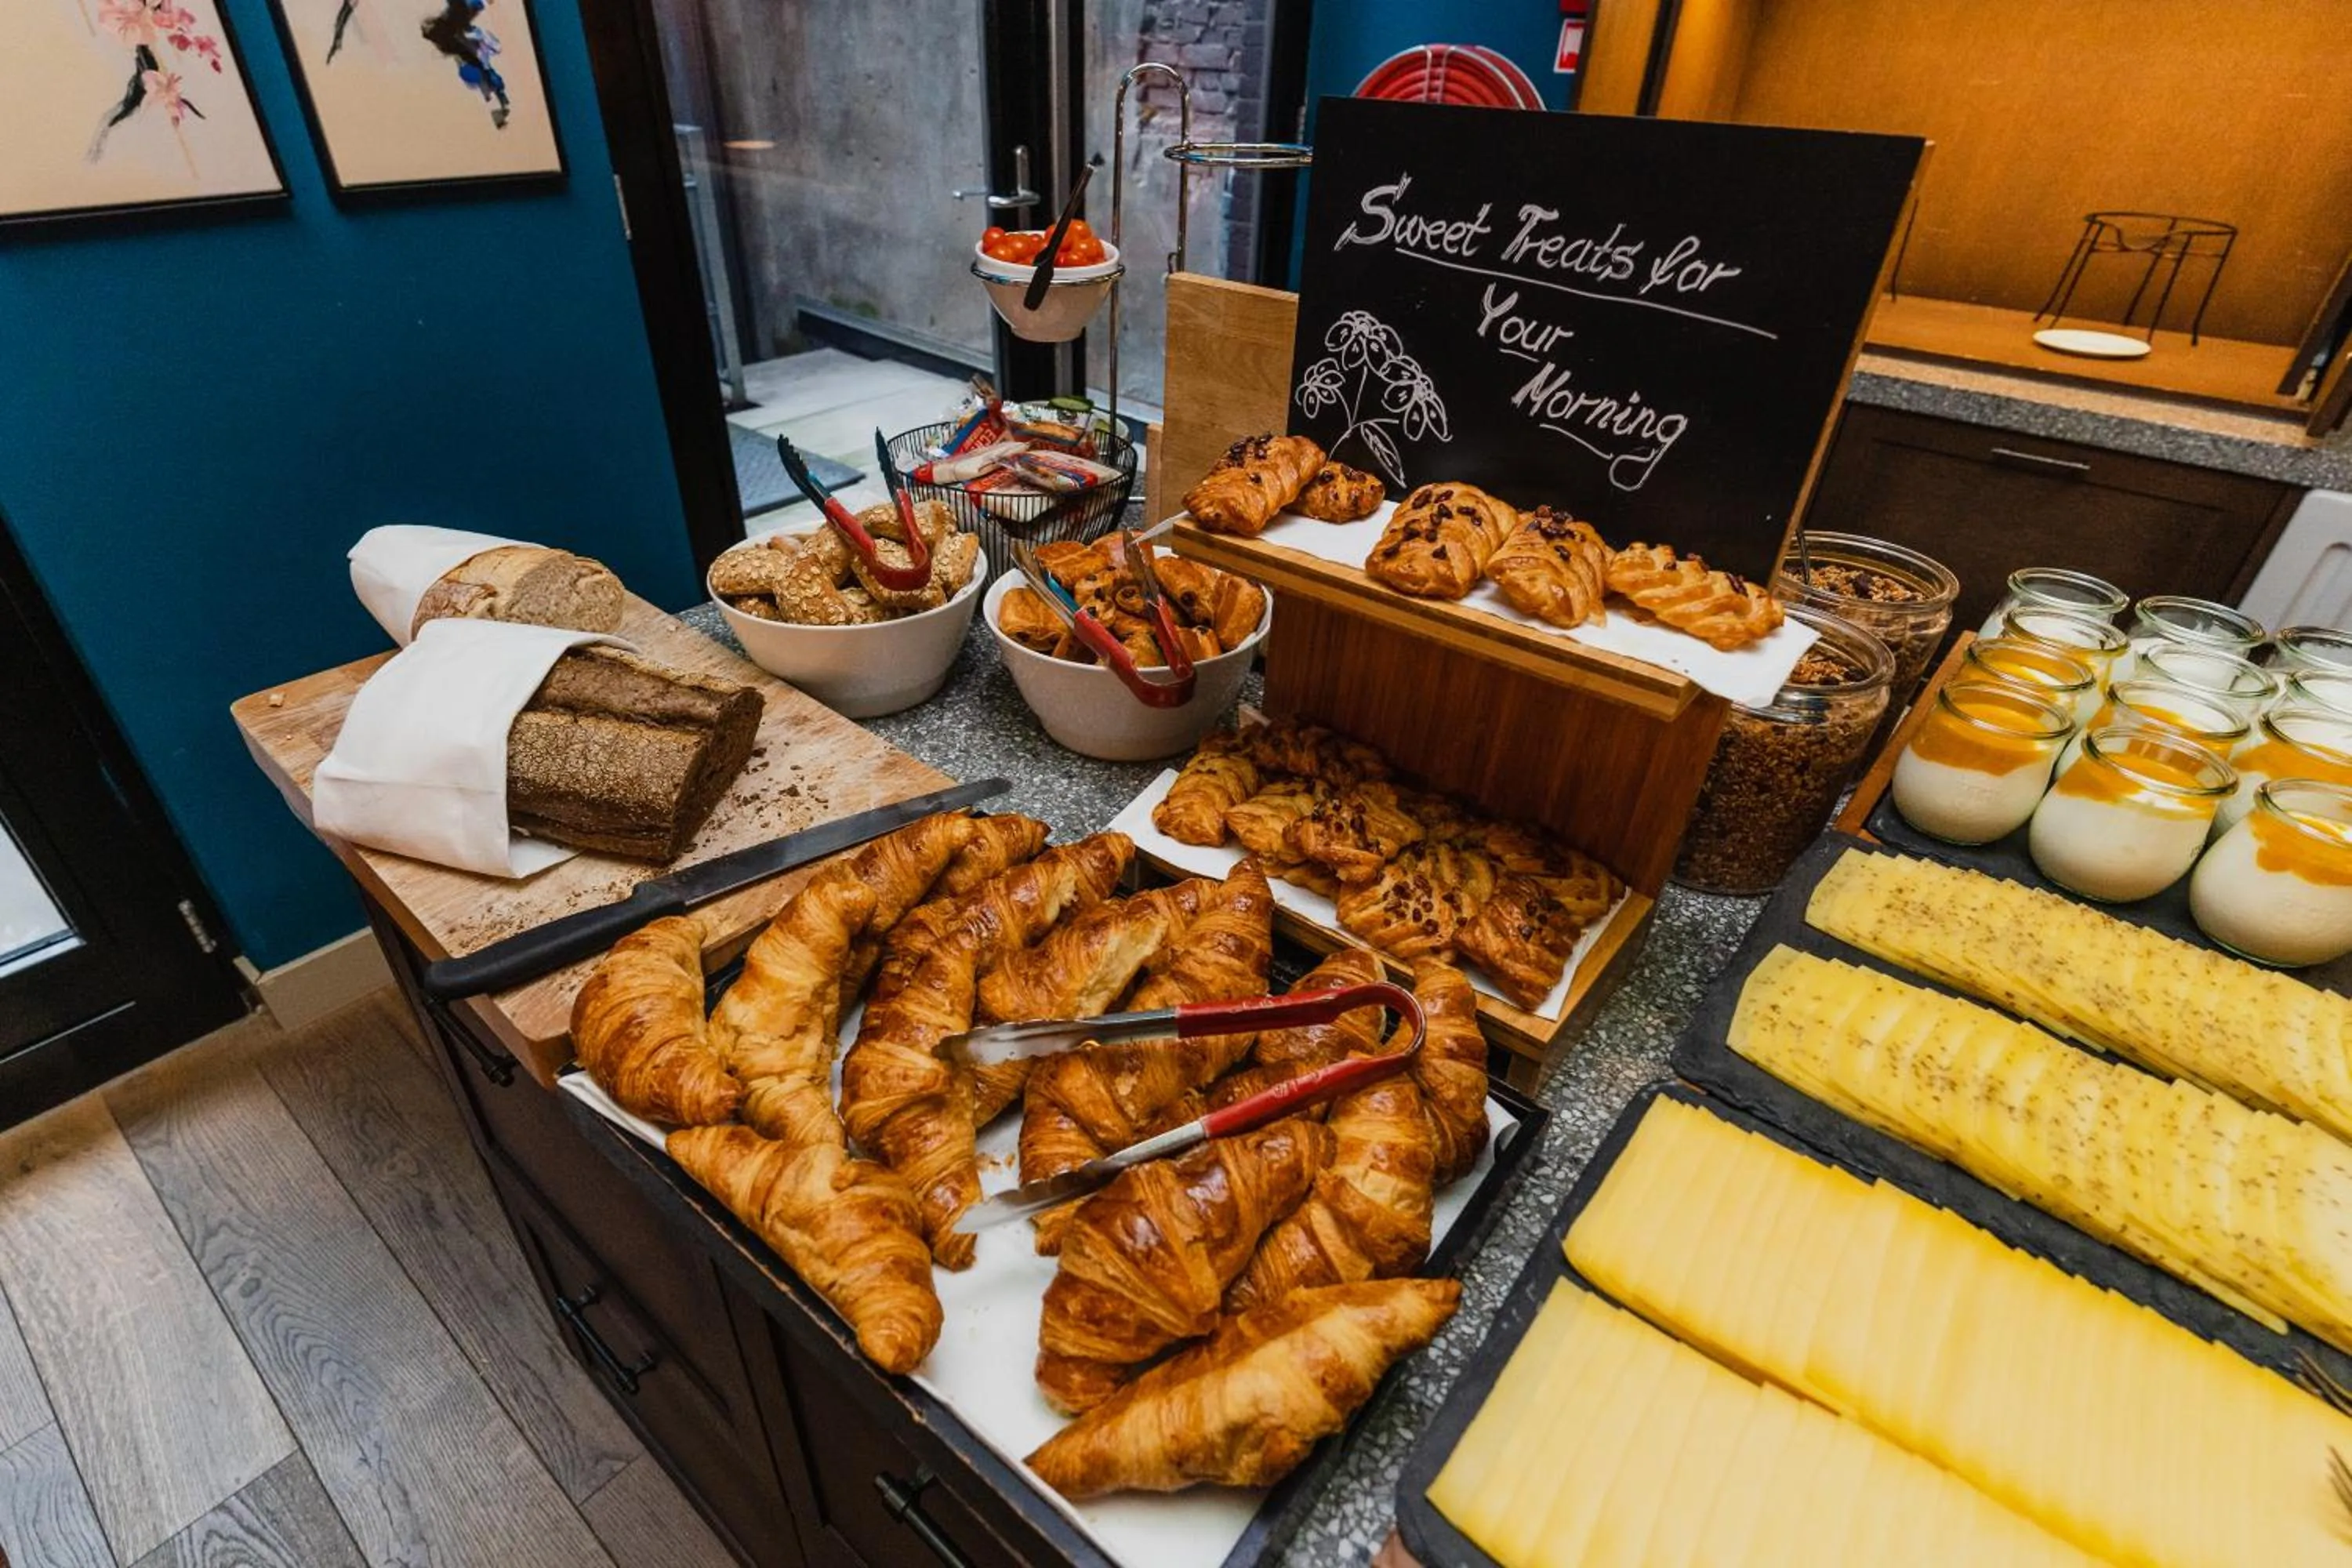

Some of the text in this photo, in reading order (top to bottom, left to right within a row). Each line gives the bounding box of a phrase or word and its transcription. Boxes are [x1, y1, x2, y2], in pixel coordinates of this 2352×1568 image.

[1334, 172, 1742, 294] Sweet Treats for
[1478, 282, 1574, 352] Your
[1511, 361, 1688, 492] Morning
